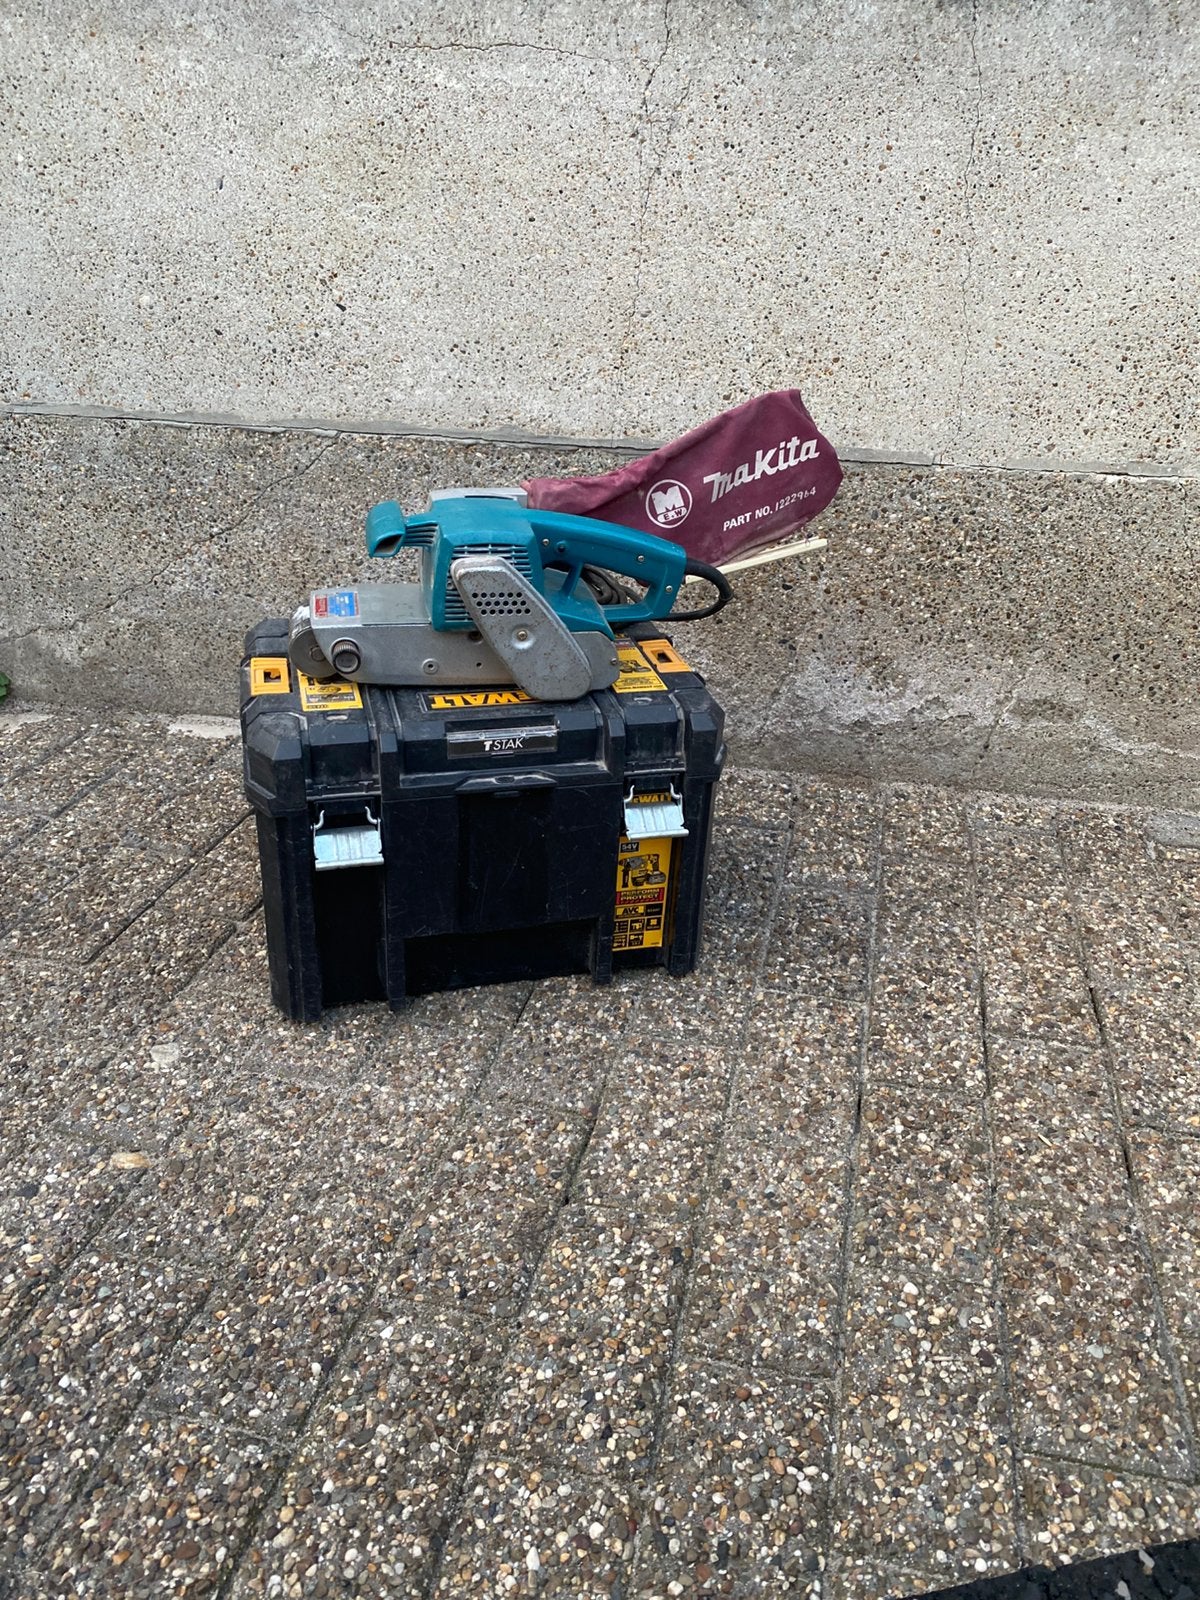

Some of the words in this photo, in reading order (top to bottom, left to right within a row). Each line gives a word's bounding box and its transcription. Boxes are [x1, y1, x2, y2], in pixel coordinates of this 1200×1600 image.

[651, 485, 685, 515] M
[723, 512, 752, 531] PART
[755, 505, 773, 520] NO.
[775, 486, 817, 512] 1222964
[431, 690, 532, 709] EWALT
